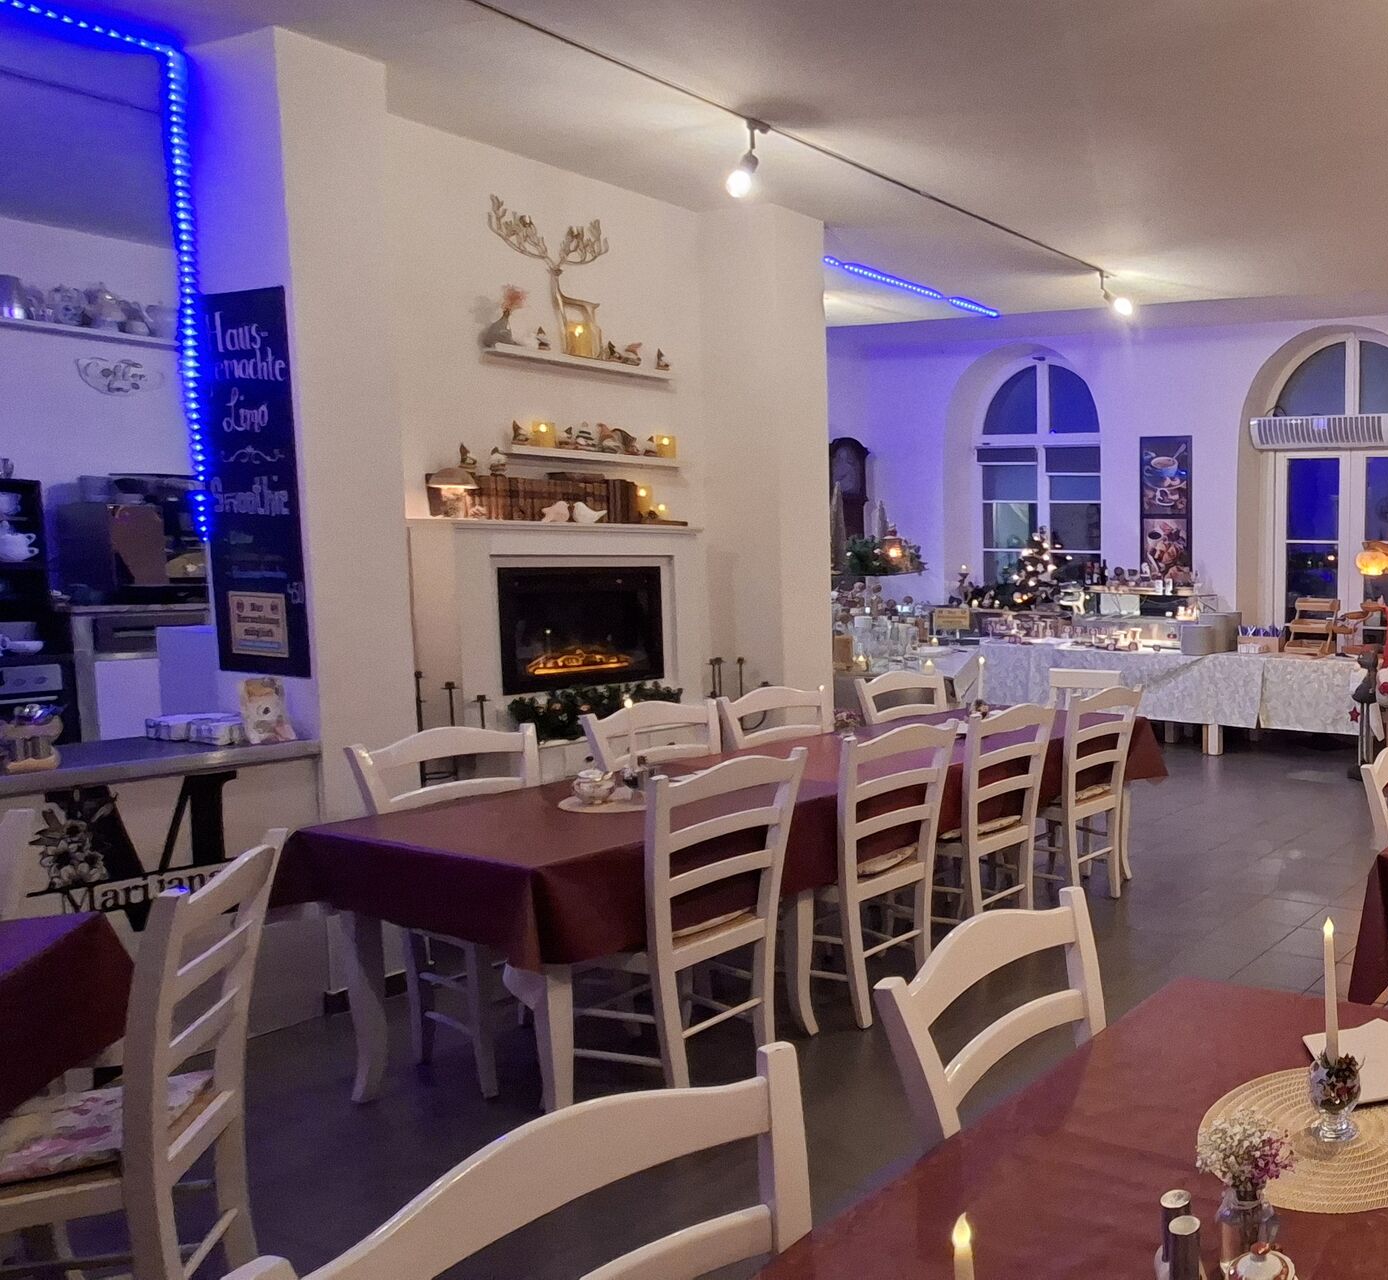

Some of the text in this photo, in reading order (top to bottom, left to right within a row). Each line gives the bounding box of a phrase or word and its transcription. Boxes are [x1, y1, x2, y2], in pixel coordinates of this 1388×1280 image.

[205, 347, 286, 381] emachte
[223, 387, 269, 432] Limo
[210, 476, 290, 516] Smoothie
